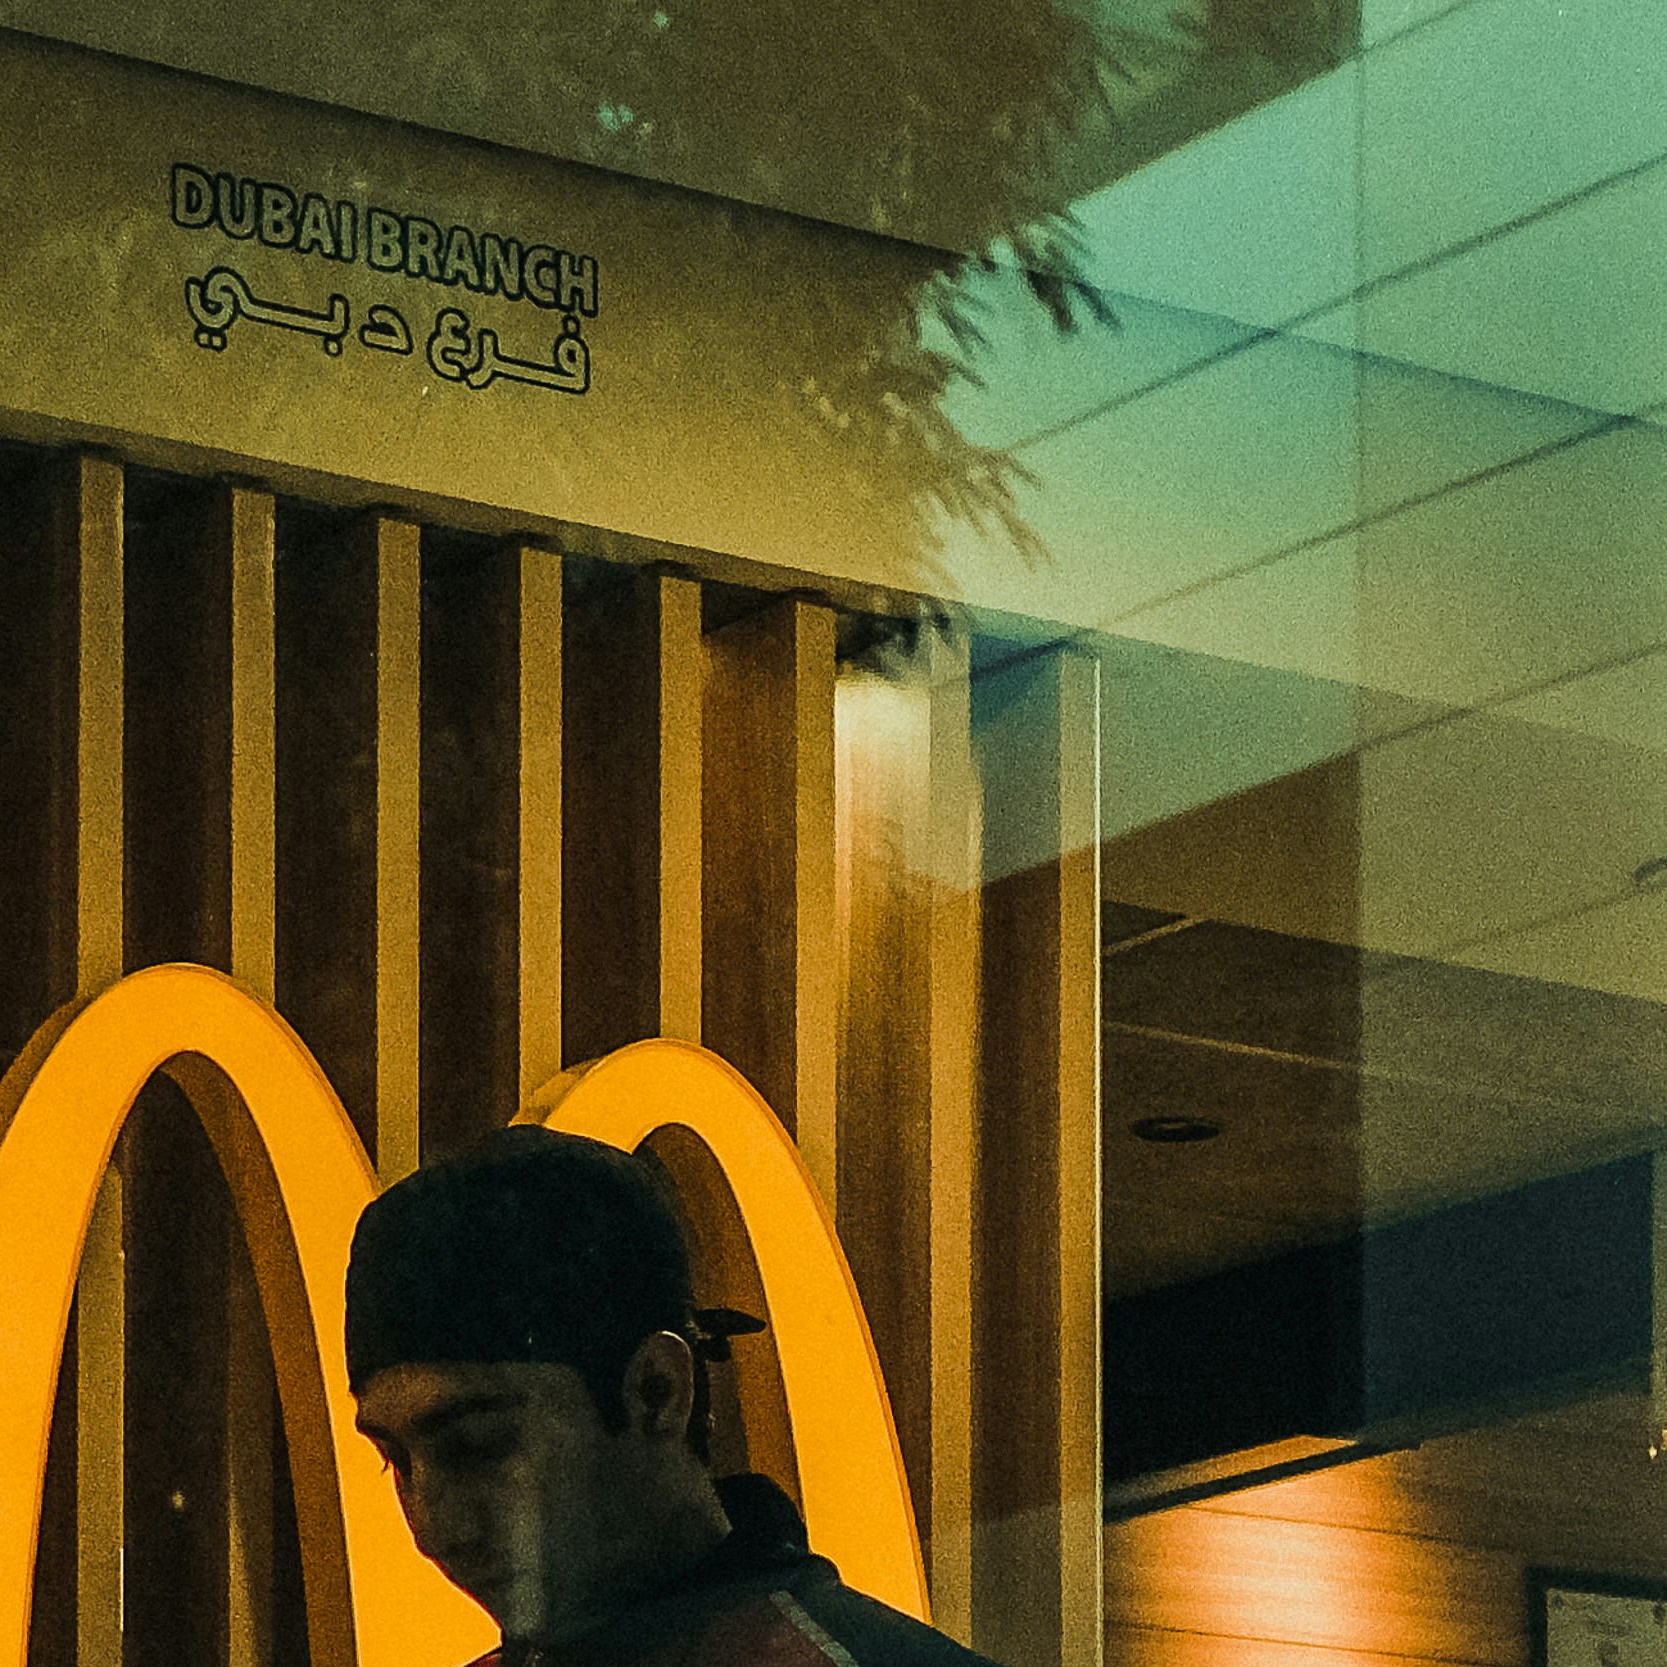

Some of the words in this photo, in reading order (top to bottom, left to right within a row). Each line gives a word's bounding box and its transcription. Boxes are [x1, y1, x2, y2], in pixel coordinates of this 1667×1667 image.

[170, 163, 357, 263] DUBAI
[364, 207, 599, 317] BRANCH
[186, 266, 414, 357] دبي
[427, 308, 590, 394] فرع
